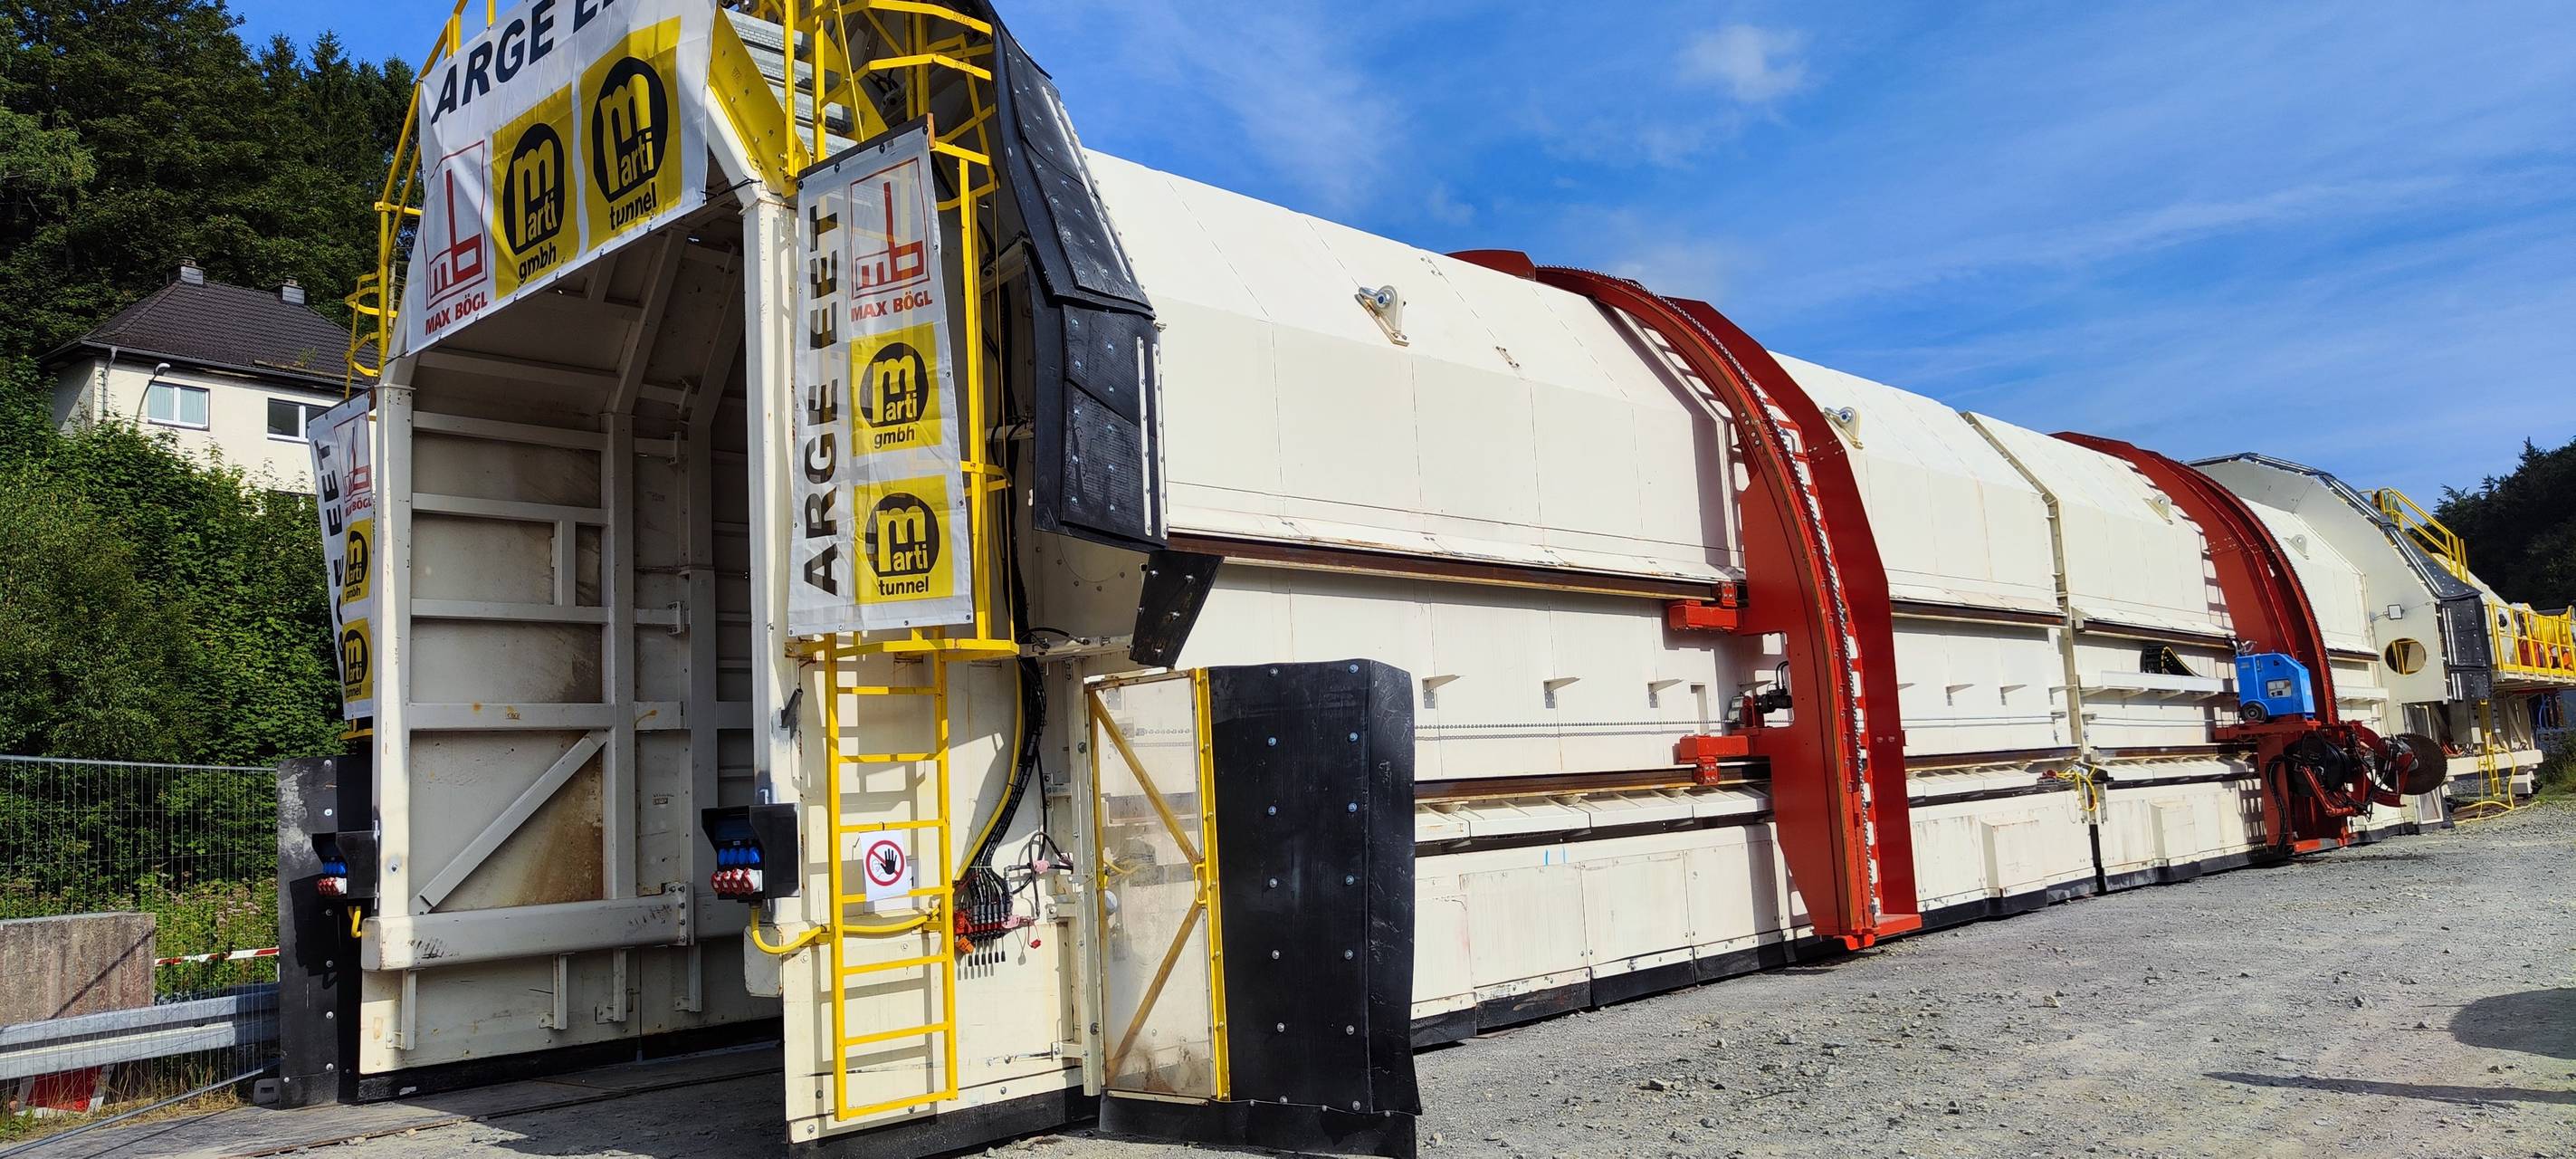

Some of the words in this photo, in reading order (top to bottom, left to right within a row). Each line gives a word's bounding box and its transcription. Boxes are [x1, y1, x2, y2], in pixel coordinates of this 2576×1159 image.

[431, 0, 555, 125] ARGE
[599, 73, 654, 195] marti
[513, 139, 558, 248] marti
[609, 182, 657, 231] tunnel
[519, 242, 557, 283] gmbh
[809, 205, 838, 350] EET
[425, 308, 451, 336] MAX
[455, 292, 488, 318] BÖGL
[851, 301, 888, 322] MAX
[892, 291, 933, 313] BÖGL
[873, 355, 918, 424] marti
[874, 426, 915, 449] gmbh
[314, 439, 342, 536] EET
[804, 378, 838, 597] ARGE
[876, 506, 928, 572] marti
[878, 576, 929, 596] tunnel
